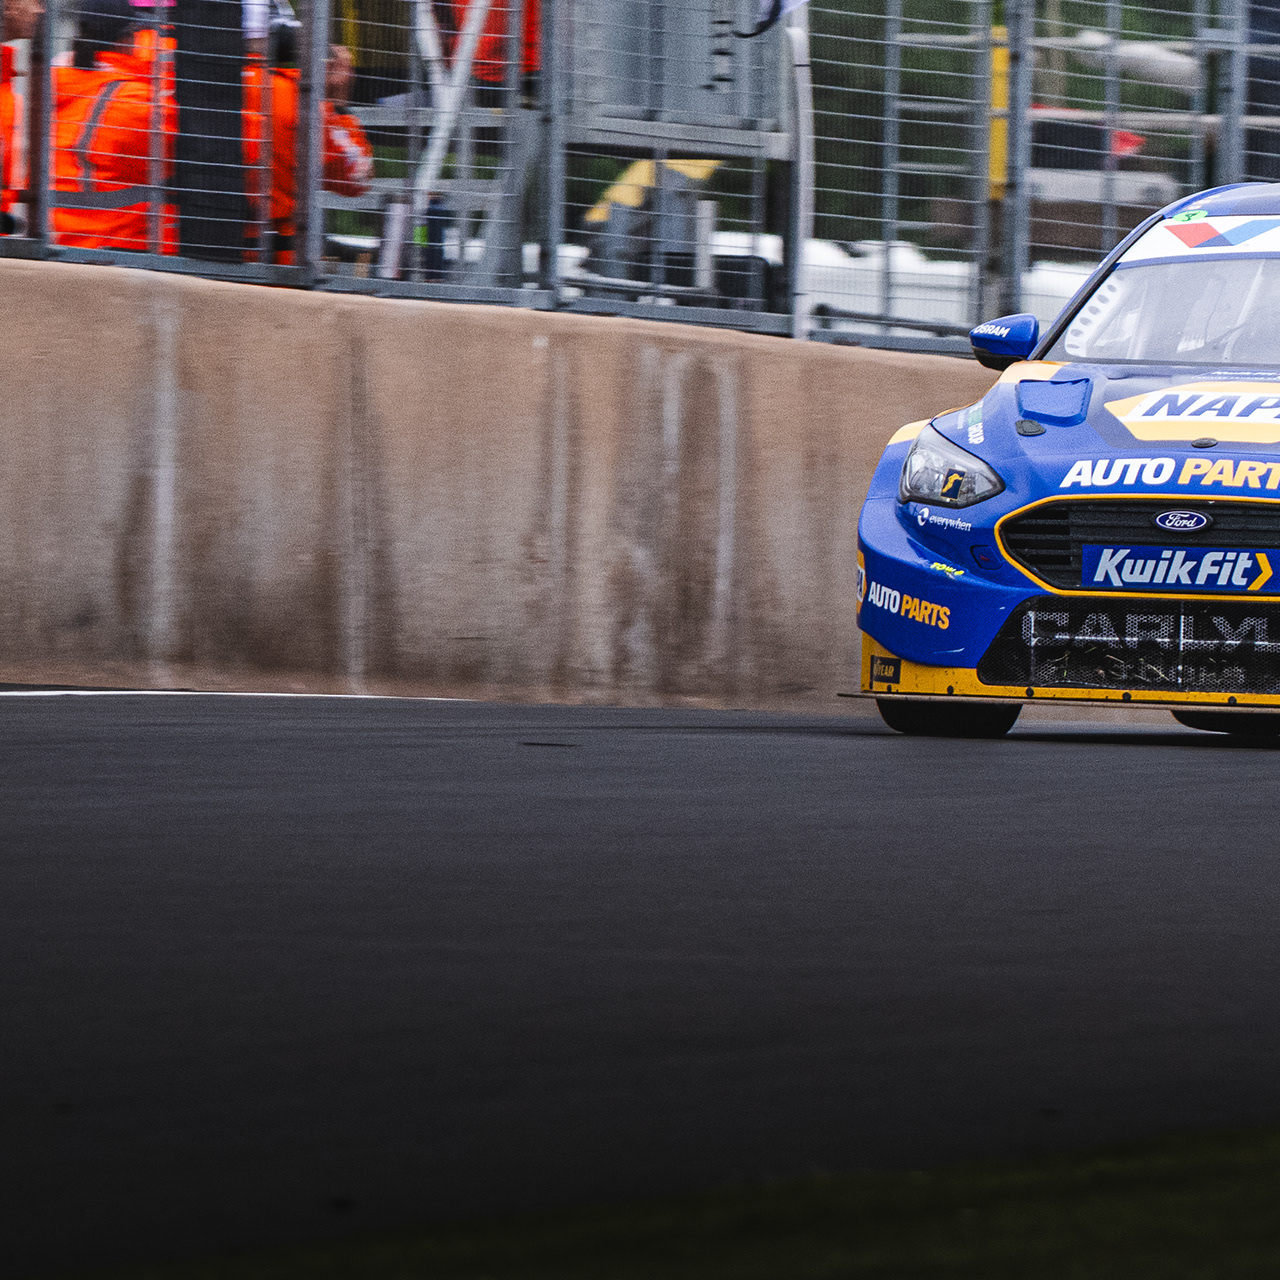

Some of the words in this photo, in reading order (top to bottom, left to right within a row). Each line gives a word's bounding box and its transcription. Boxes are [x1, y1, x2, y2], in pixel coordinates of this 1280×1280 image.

[973, 324, 1011, 338] OSRAM
[1060, 457, 1176, 488] AUTO
[929, 514, 972, 532] everywhen
[1165, 513, 1199, 528] Ford
[868, 581, 901, 614] AUTO
[900, 594, 951, 630] PARTS
